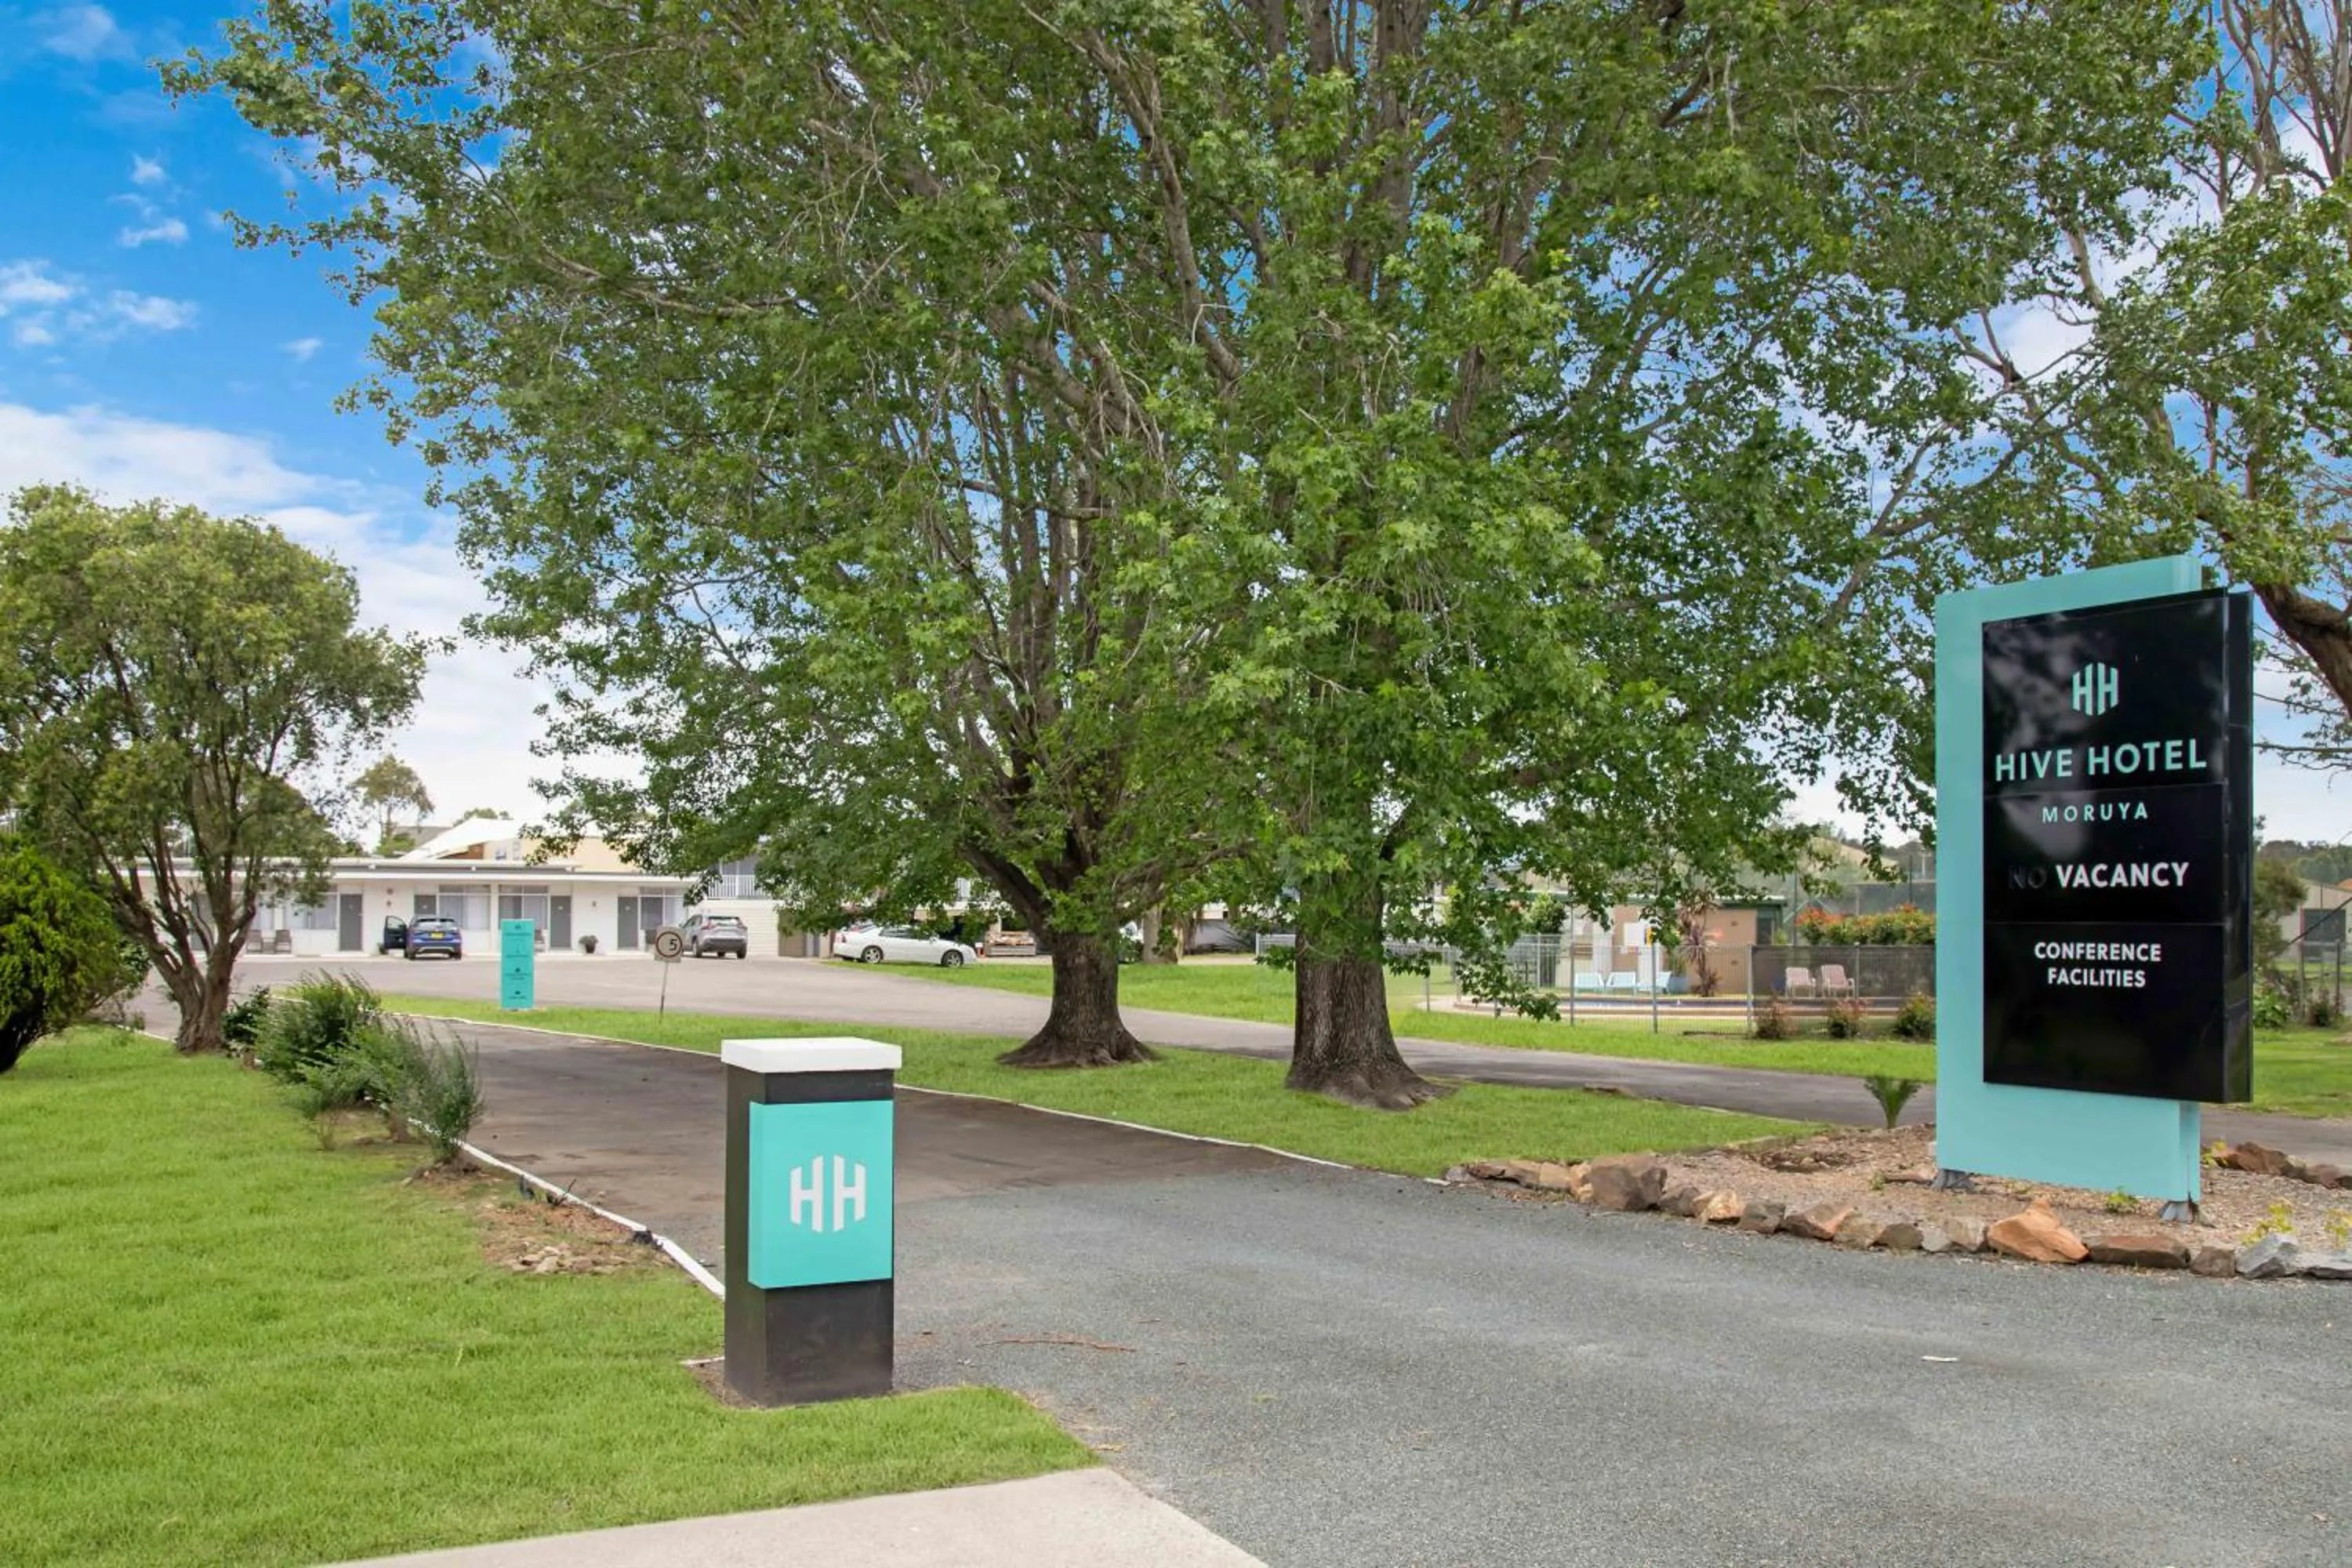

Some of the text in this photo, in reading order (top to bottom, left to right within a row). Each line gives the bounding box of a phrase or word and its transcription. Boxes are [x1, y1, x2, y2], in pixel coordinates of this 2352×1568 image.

[2072, 662, 2119, 716] HH
[1995, 739, 2207, 782] HIVE HOTEL
[2042, 802, 2148, 823] MORUYA
[2008, 862, 2190, 890] NO VACANCY
[2034, 942, 2162, 962] CONFERENCE
[2047, 967, 2147, 989] FACILITIES
[789, 1154, 866, 1233] HH
